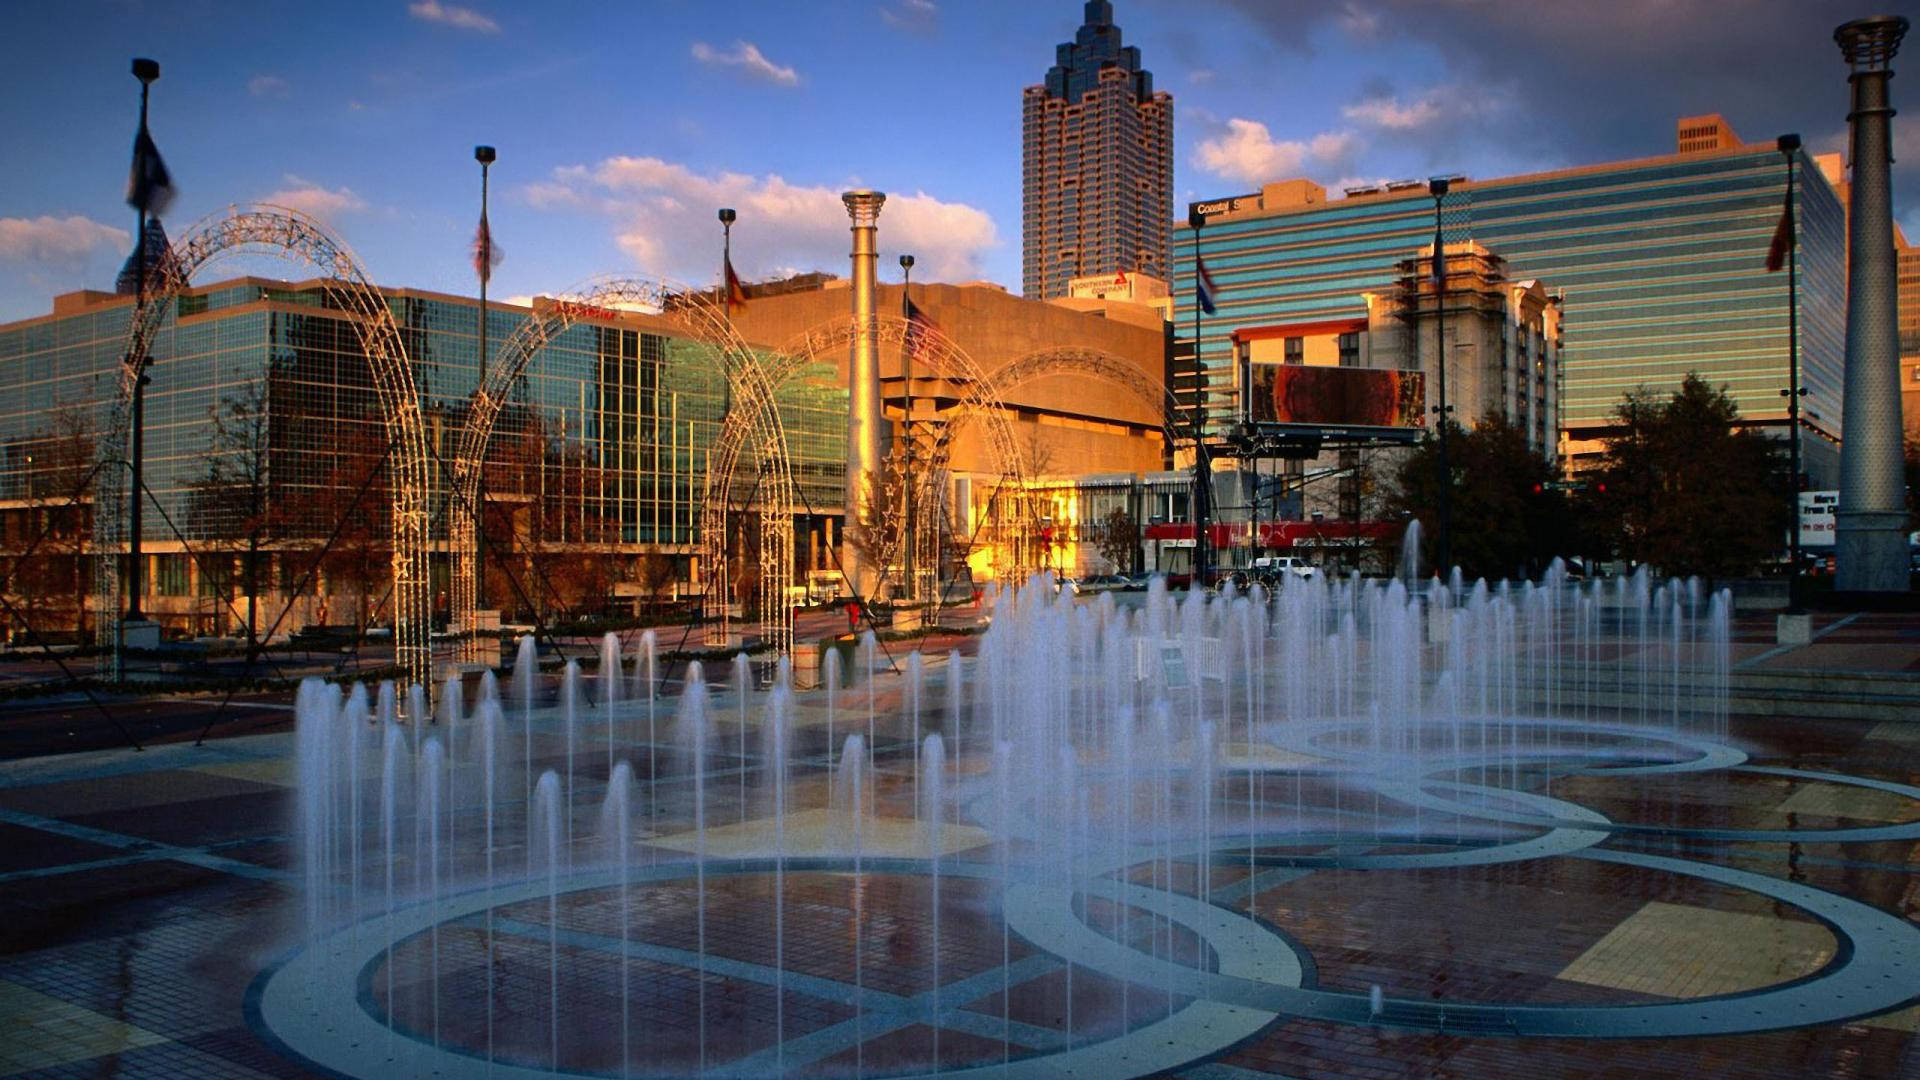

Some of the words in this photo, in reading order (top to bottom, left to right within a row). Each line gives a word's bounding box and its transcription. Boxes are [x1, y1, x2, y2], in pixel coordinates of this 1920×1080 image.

[1197, 201, 1229, 215] Coastal
[1073, 279, 1113, 290] SOUTHERN
[1091, 284, 1127, 295] COMPANY
